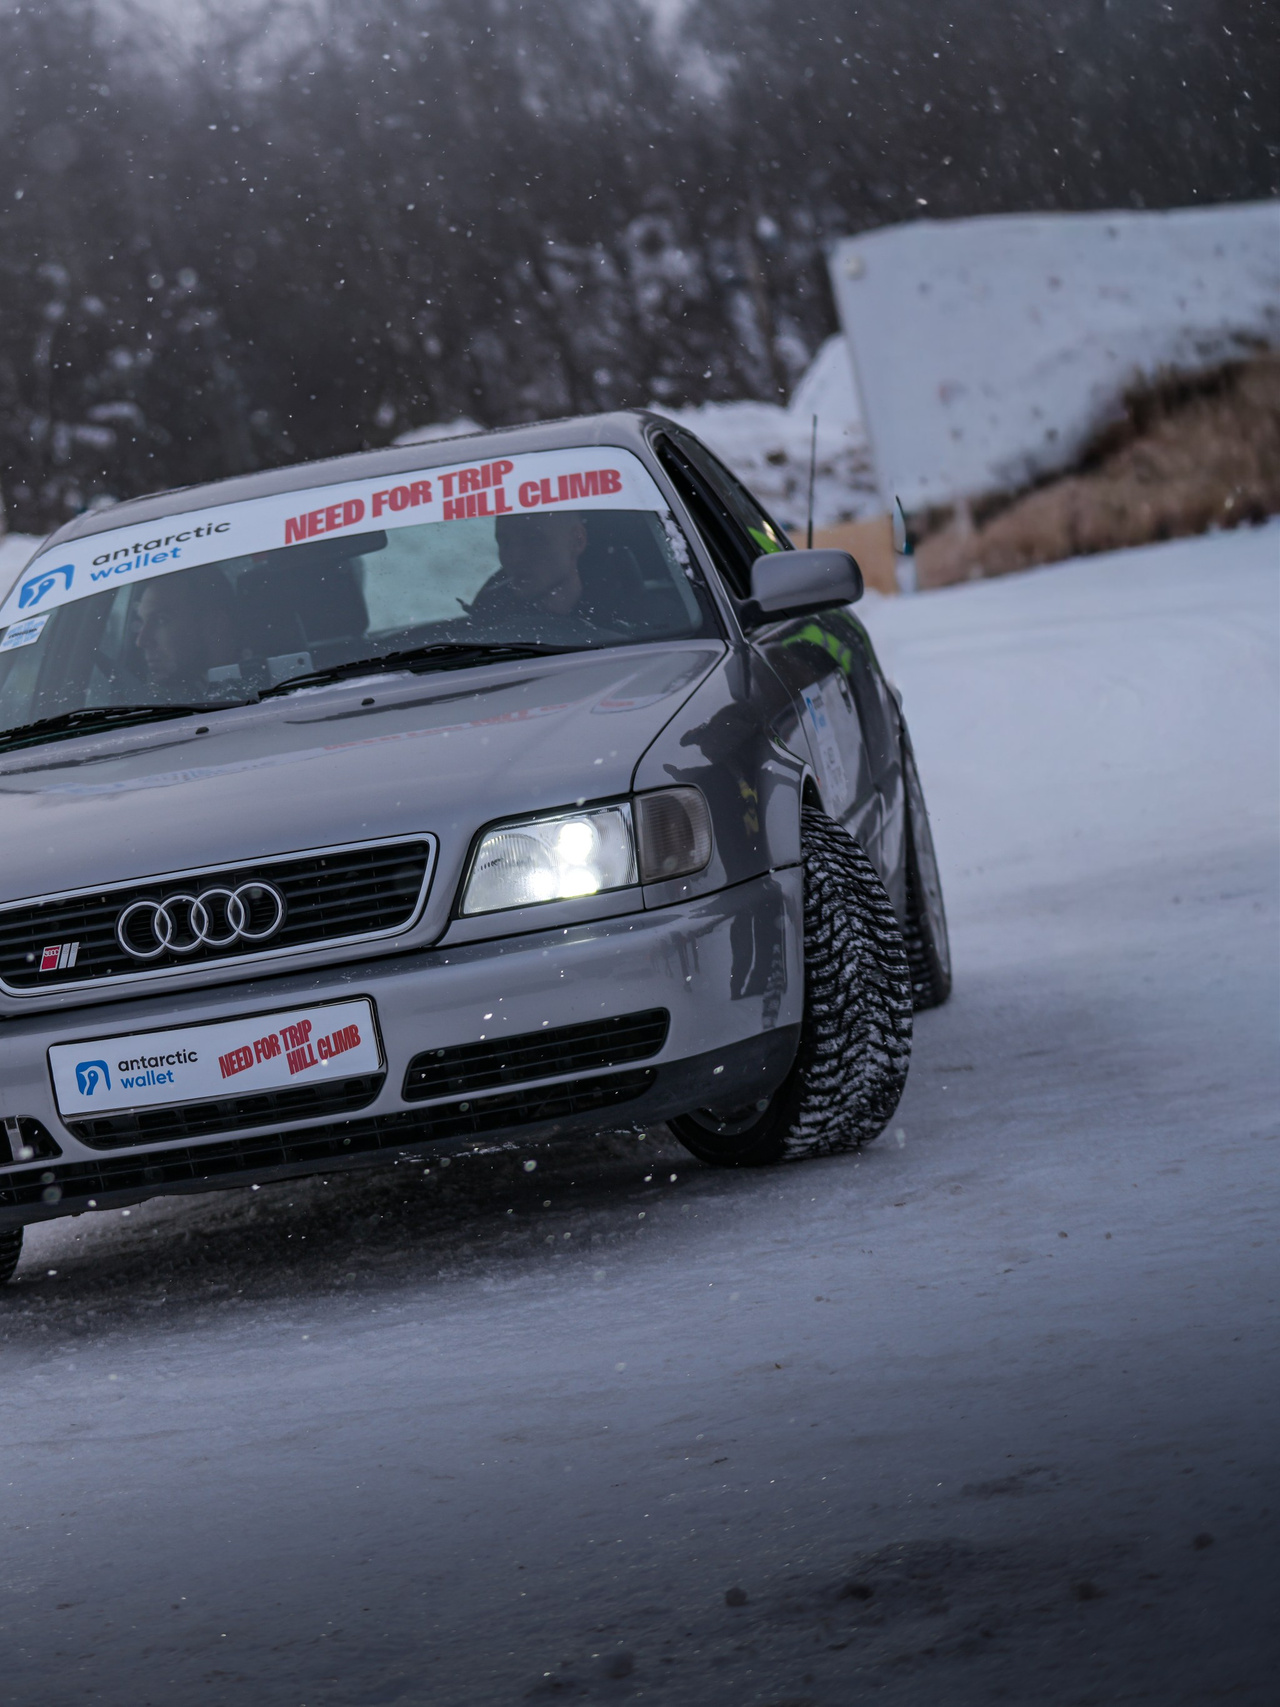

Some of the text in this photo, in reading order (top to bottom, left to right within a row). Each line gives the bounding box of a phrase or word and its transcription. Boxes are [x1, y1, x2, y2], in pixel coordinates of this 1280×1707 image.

[284, 460, 514, 545] NEED FOR TRIP
[442, 468, 623, 521] HILL CLIMB
[90, 547, 182, 582] wallet
[92, 522, 231, 566] antarctic
[118, 1049, 198, 1072] antarctic
[218, 1019, 312, 1079] NEED FOR TRIP
[286, 1024, 361, 1075] HILL CLIMB
[120, 1070, 174, 1089] wallet
